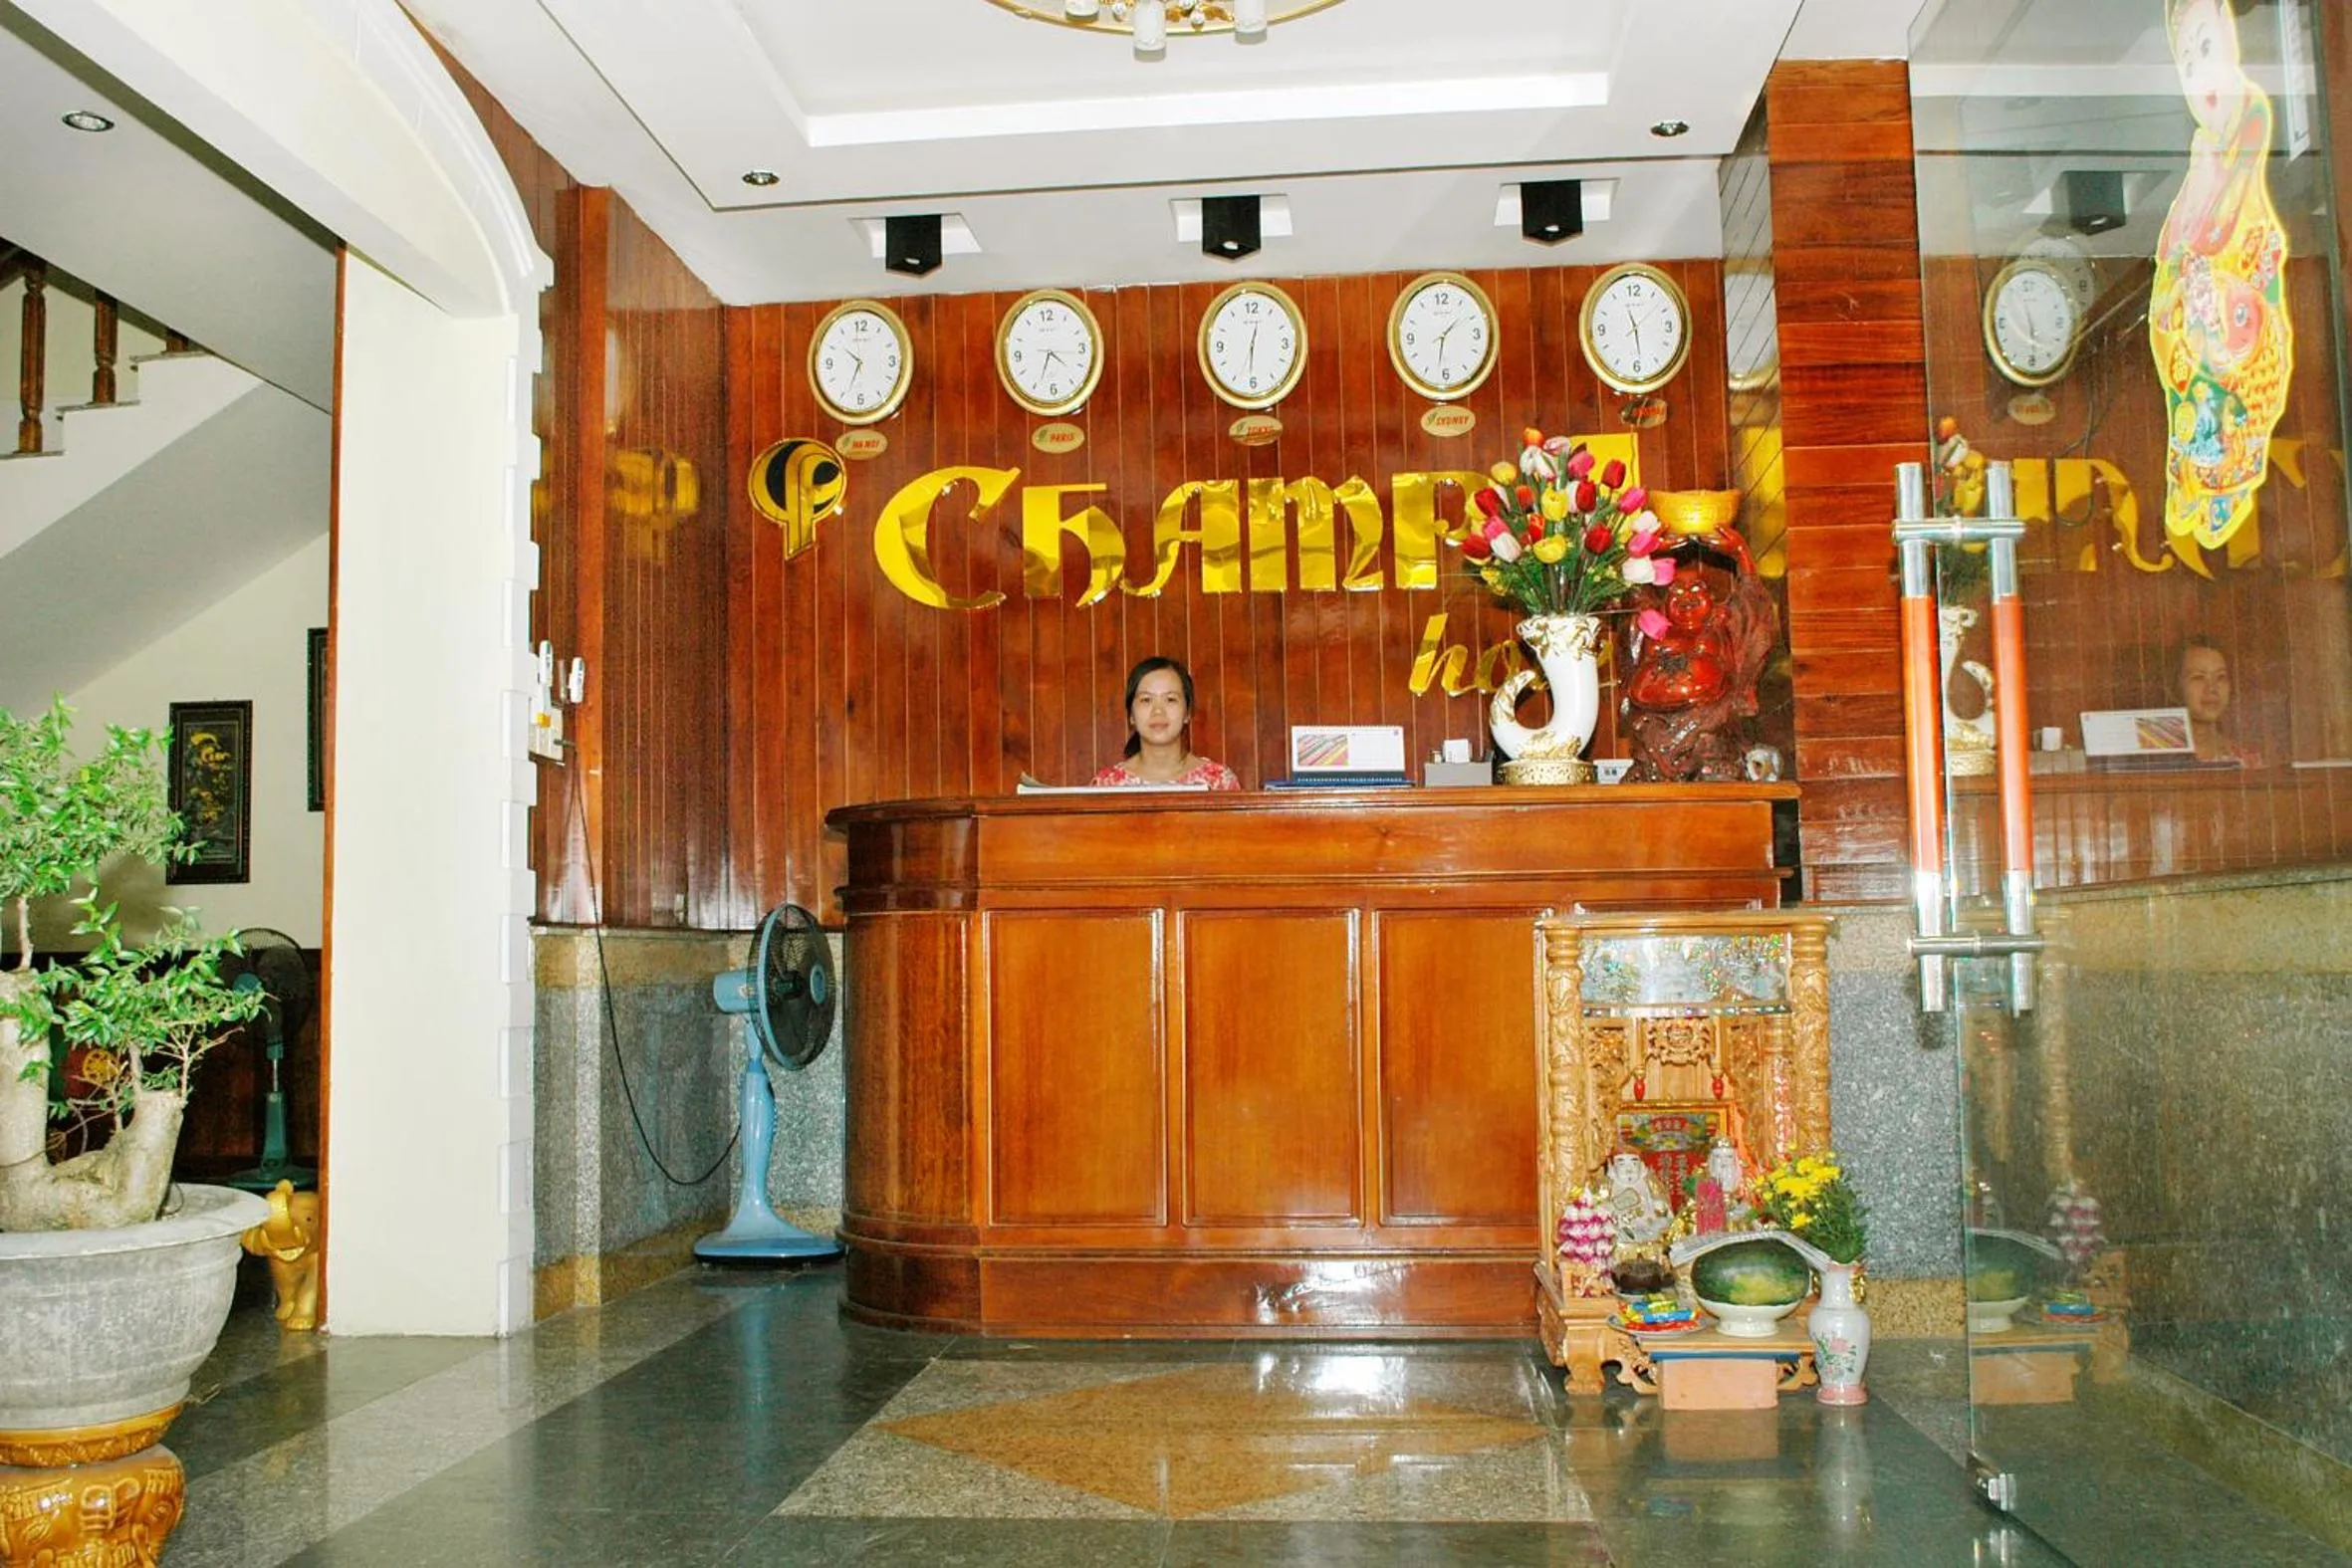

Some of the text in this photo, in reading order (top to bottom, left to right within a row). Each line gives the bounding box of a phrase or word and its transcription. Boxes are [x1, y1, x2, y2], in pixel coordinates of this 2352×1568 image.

[1627, 285, 1641, 297] 12
[1435, 294, 1449, 305] 12
[1245, 303, 1259, 314] 12
[1040, 310, 1054, 322] 12
[854, 321, 868, 332] 12
[1597, 325, 1605, 336] 9
[1665, 321, 1672, 333] 3
[1406, 334, 1414, 344] 9
[1474, 329, 1481, 340] 3
[1078, 342, 1085, 354] 3
[1217, 341, 1224, 352] 9
[1282, 337, 1289, 348] 3
[888, 355, 896, 367] 3
[1014, 350, 1022, 362] 9
[825, 358, 833, 369] 9
[1633, 360, 1641, 372] 6
[1442, 368, 1450, 380] 6
[1249, 377, 1257, 388] 6
[1050, 383, 1058, 395] 6
[856, 394, 864, 405] 6
